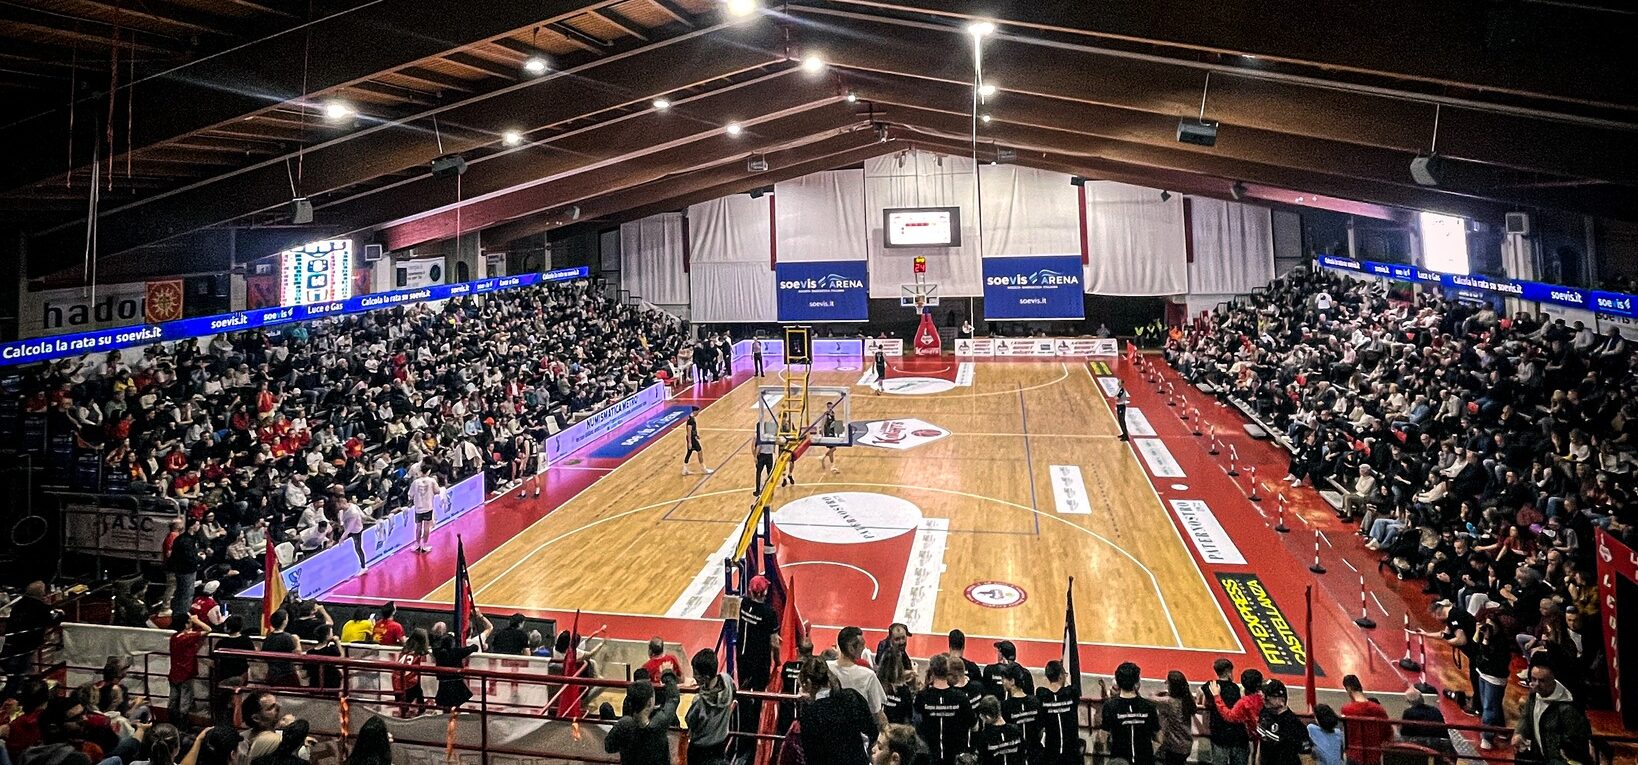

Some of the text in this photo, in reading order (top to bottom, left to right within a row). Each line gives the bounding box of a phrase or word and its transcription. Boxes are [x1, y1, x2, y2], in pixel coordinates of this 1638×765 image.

[780, 278, 864, 289] soevis ARENA
[987, 274, 1079, 285] soevis ARENA
[1453, 276, 1471, 286] Calcola
[1478, 280, 1490, 289] rata
[1497, 282, 1523, 294] soevis.it
[361, 296, 383, 307] Calcola
[384, 295, 390, 303] la
[409, 290, 431, 300] soevis.it
[1551, 289, 1583, 303] soevis.it
[308, 306, 323, 314] Luce
[331, 303, 344, 311] Gas
[211, 314, 247, 329] soevis.it
[3, 327, 161, 359] Calcola la rata su soevis.it
[586, 404, 622, 430] NUMISMATICA
[1176, 502, 1224, 560] PATERNOSTRO
[1246, 579, 1306, 665] CASTELLANZA
